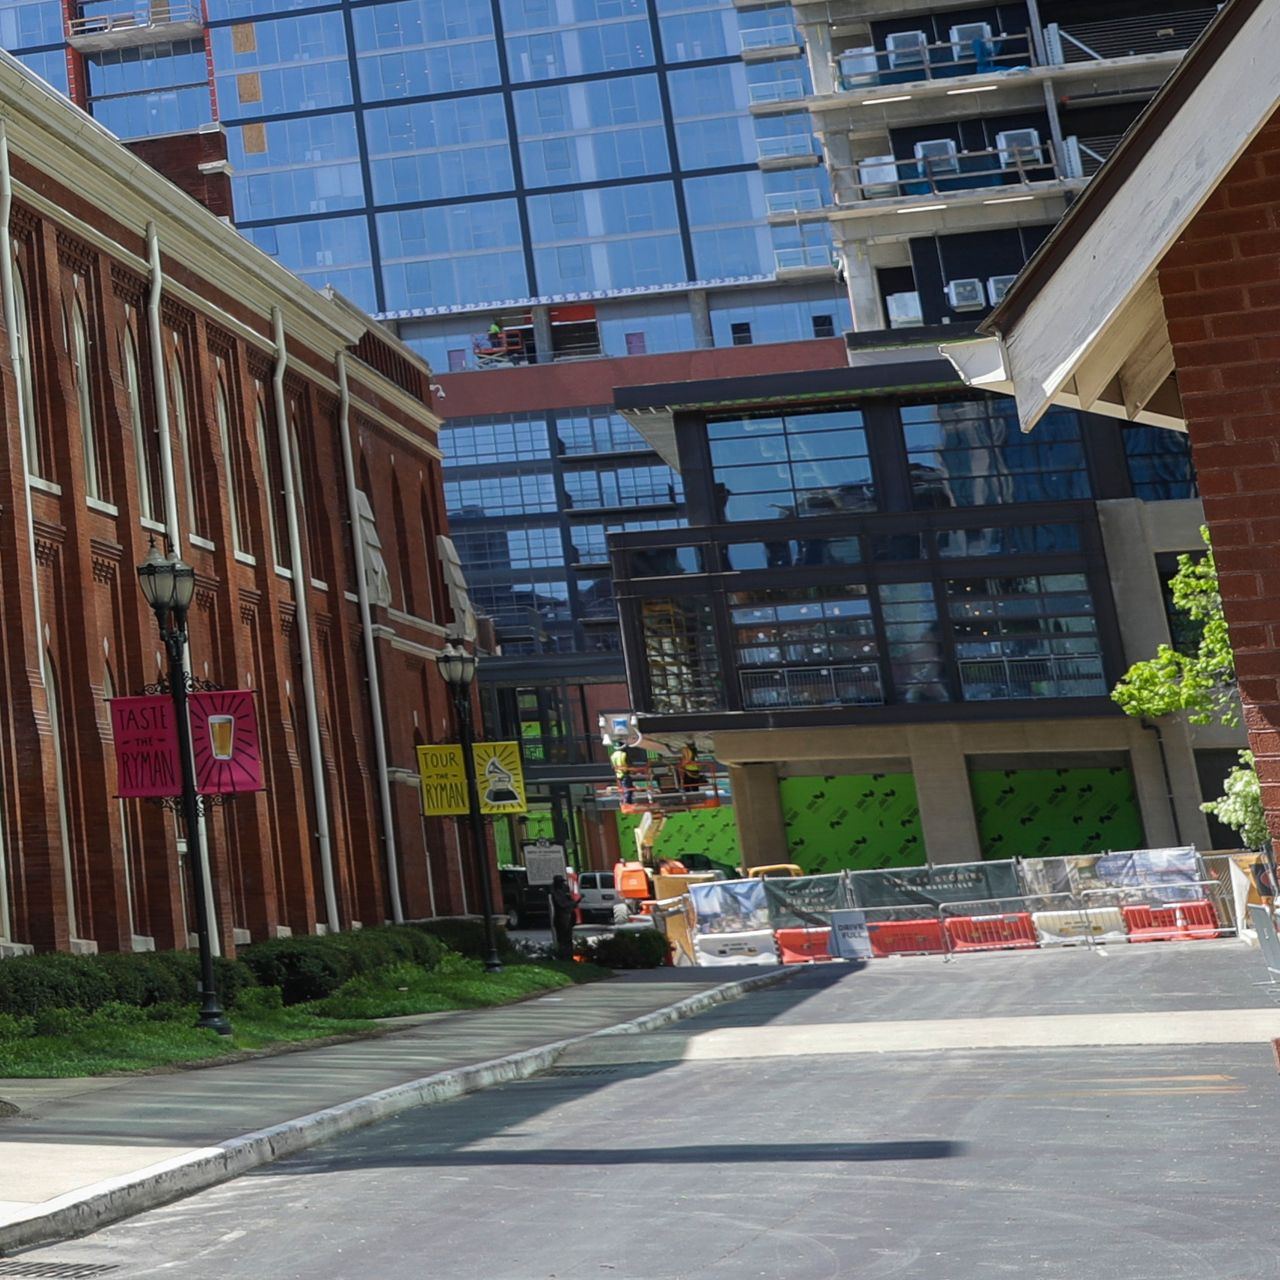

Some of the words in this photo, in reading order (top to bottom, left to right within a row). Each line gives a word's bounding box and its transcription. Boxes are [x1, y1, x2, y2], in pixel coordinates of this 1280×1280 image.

[117, 705, 168, 731] TASTE
[136, 738, 153, 747] THE
[121, 750, 175, 789] RYMAN
[422, 752, 459, 769] TOUR
[425, 782, 466, 809] RYMAN
[838, 923, 864, 932] DRIVE
